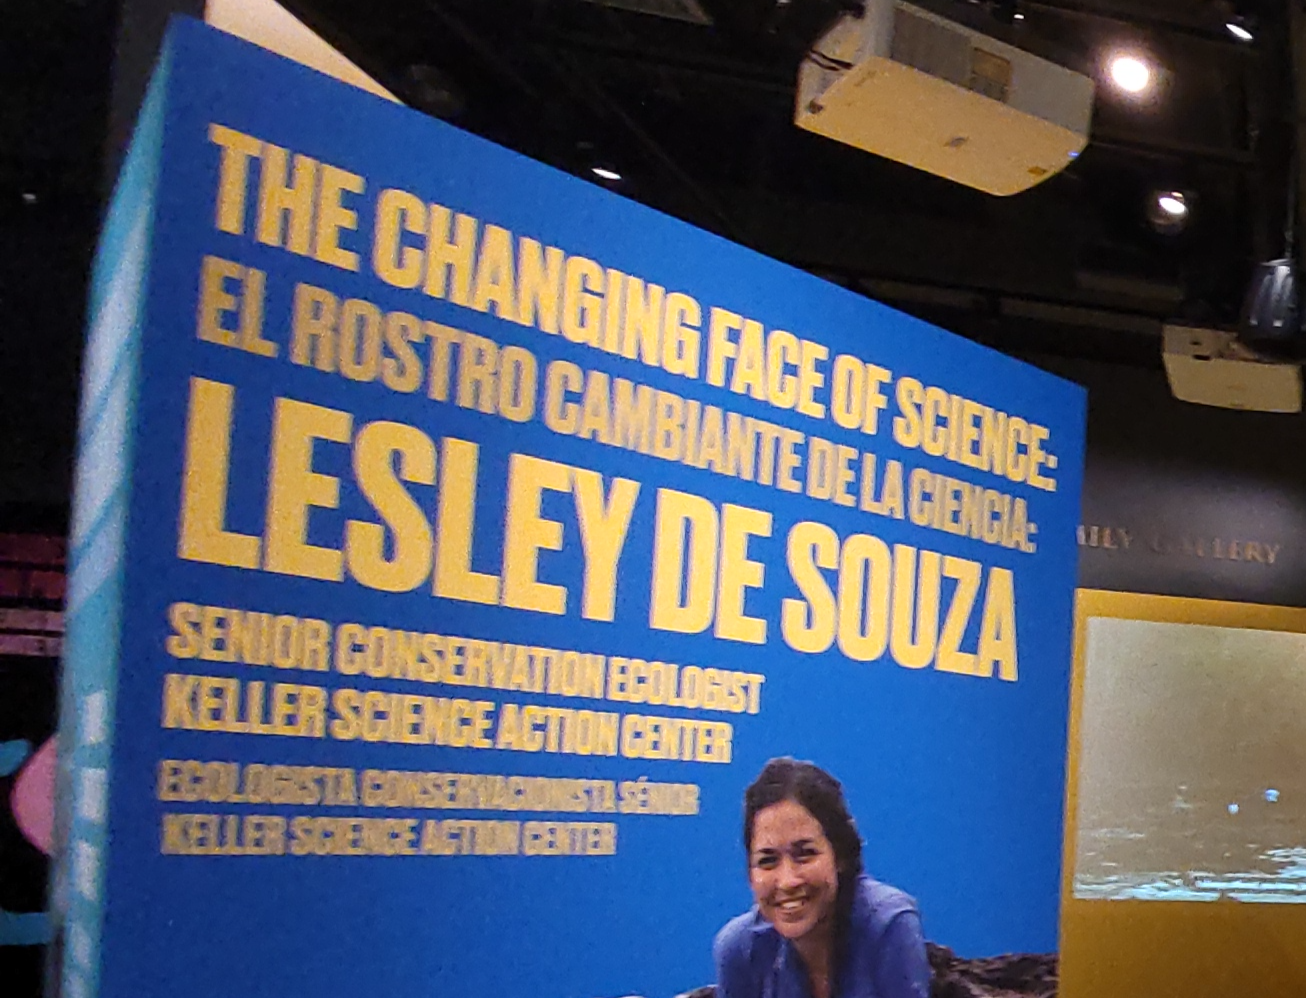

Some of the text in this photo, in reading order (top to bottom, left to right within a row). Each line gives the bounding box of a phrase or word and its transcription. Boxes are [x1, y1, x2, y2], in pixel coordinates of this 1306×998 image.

[209, 123, 1058, 492] THE CHANGING FACE OF SCIENCE:
[197, 255, 1037, 553] EL ROSTRO CAMBIANTE DE LA CIENCIA:
[177, 376, 641, 622] LESLEY
[650, 488, 773, 645] DE
[781, 521, 1019, 682] SOUZA
[165, 601, 766, 714] SENIOR CONSERVATION ECOLOGIST
[161, 673, 734, 764] KELLER SCIENCE ACTION CENTER
[158, 759, 356, 806] ECOLOGISTA
[360, 769, 616, 812] CONSERVACIONISTA
[161, 814, 616, 856] KELLER SCIENCE ACTION CENTER
